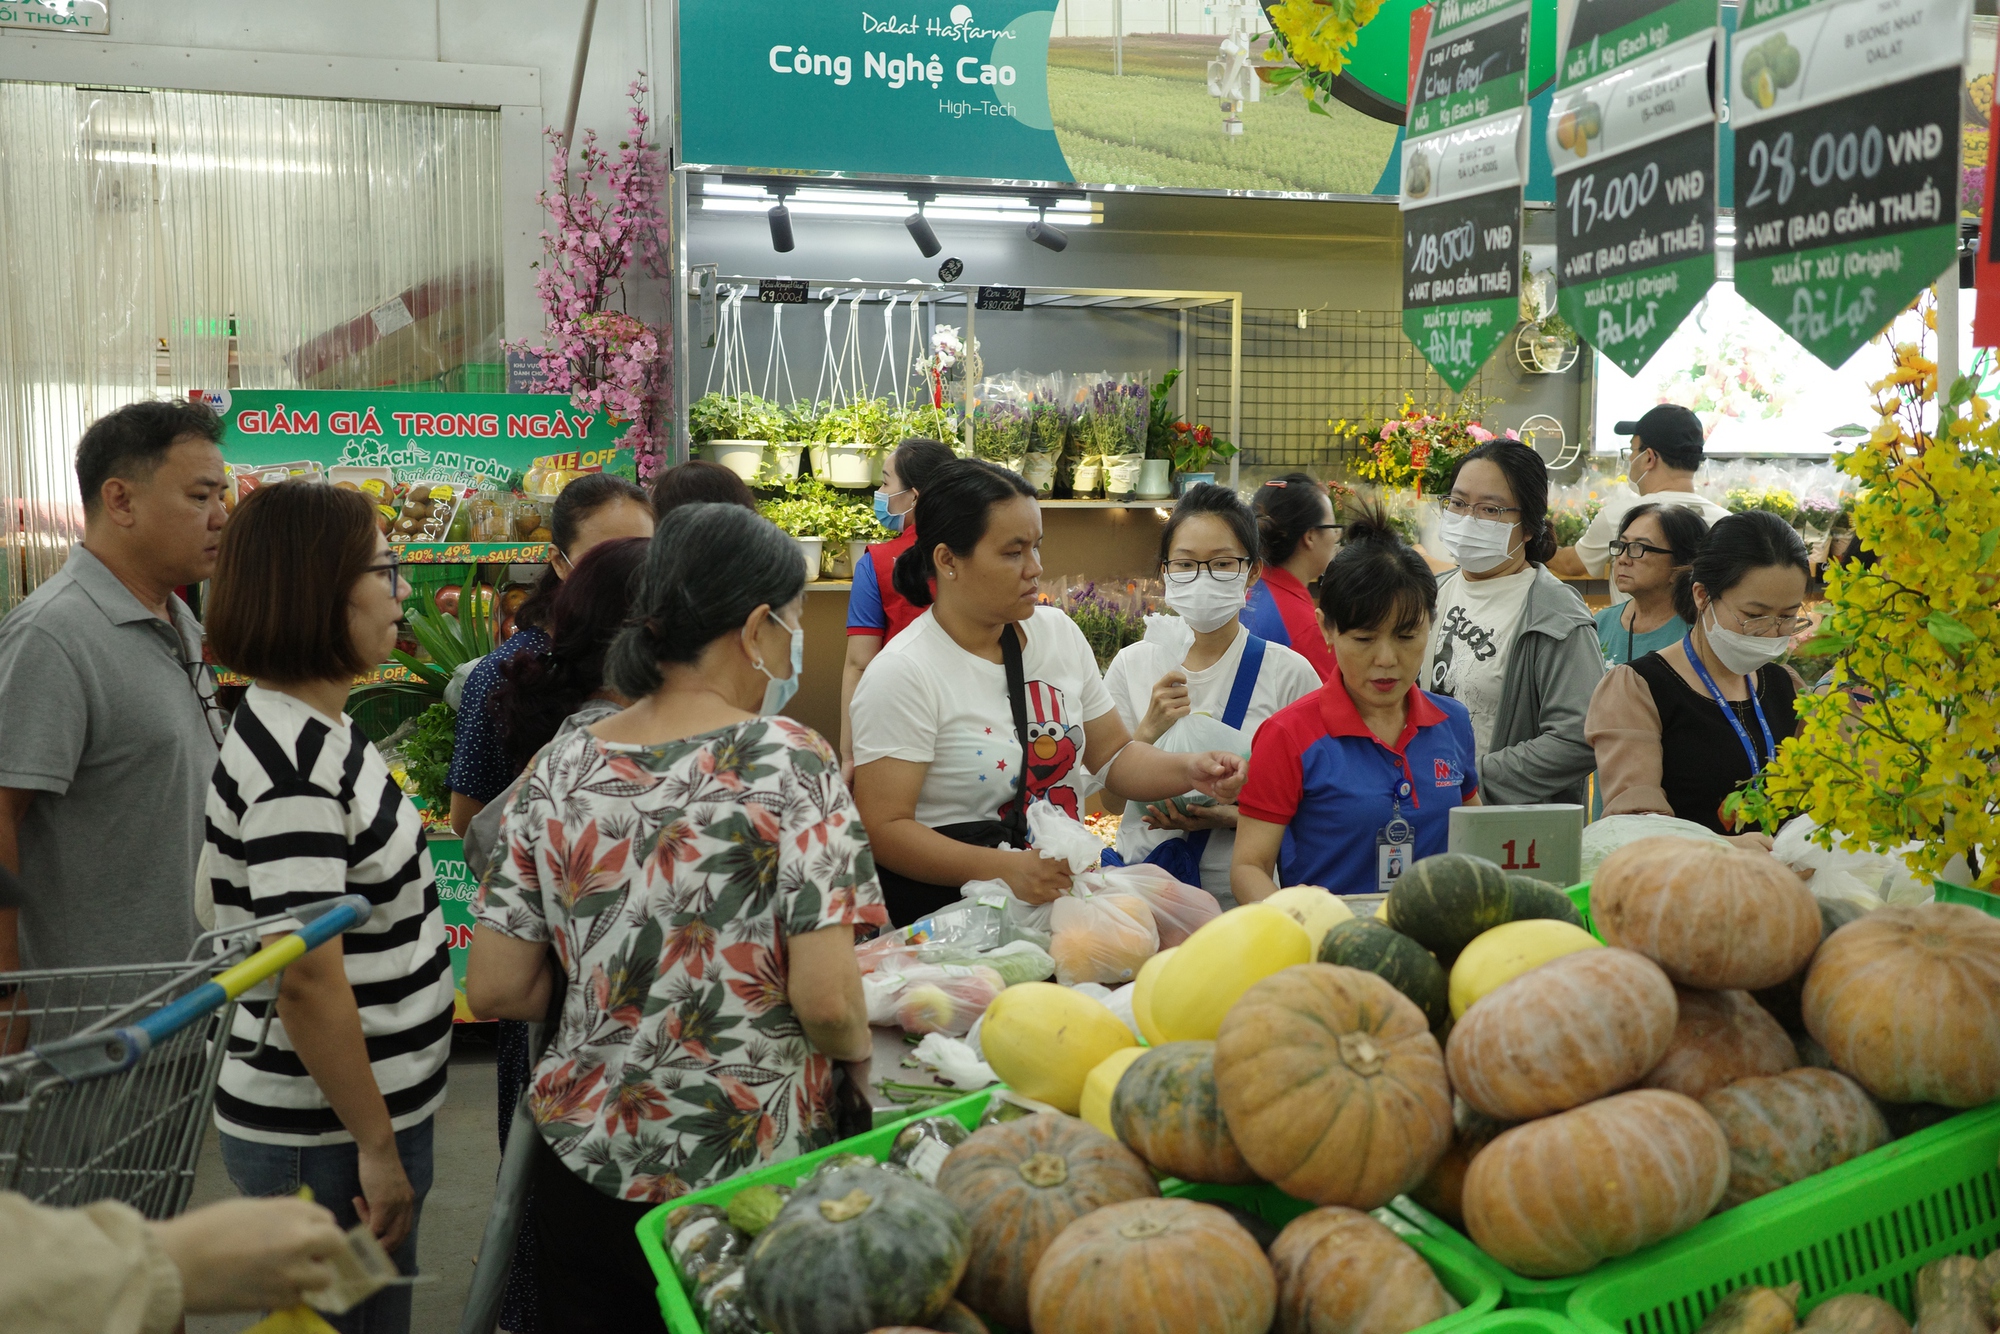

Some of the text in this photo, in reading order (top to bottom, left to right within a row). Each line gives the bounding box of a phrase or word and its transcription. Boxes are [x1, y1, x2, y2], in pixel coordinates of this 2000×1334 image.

[24, 11, 93, 26] THOÁT
[862, 12, 1016, 43] Dalat Hasfarm
[769, 45, 1016, 89] Công Nghệ Cao
[1588, 33, 1599, 74] 1
[1601, 48, 1616, 68] Kg
[1617, 32, 1648, 63] (Each
[1440, 109, 1451, 127] Kg
[1452, 100, 1474, 123] (Each
[1745, 123, 1943, 207] 28.000 VNĐ
[1567, 162, 1705, 237] 13.000 VNĐ
[1744, 219, 1784, 250] +VAT
[1787, 211, 1829, 246] (BAO
[1880, 175, 1941, 222] THUẾ)
[1484, 225, 1512, 251] VNĐ
[1564, 252, 1594, 278] +VAT
[1595, 243, 1626, 275] (BAO
[1661, 213, 1705, 255] THUẾ)
[1771, 252, 1812, 286] XUẤT
[1843, 245, 1904, 279] (Origin):
[1408, 282, 1430, 301] +VAT
[1432, 279, 1454, 302] (BAO
[1481, 262, 1511, 293] THUẾ)
[1584, 278, 1615, 308] XUẤT
[238, 404, 595, 438] GIẢM GIÁ TRONG NGÀY
[435, 453, 457, 468] AN
[466, 457, 510, 482] TOÀN
[533, 449, 617, 471] SALE OFF
[392, 545, 406, 556] FF
[407, 548, 434, 562] 30%
[444, 544, 471, 558] 49%
[488, 550, 518, 563] SALE
[521, 545, 545, 559] OFF
[383, 666, 408, 680] OFF
[1501, 838, 1541, 870] 11
